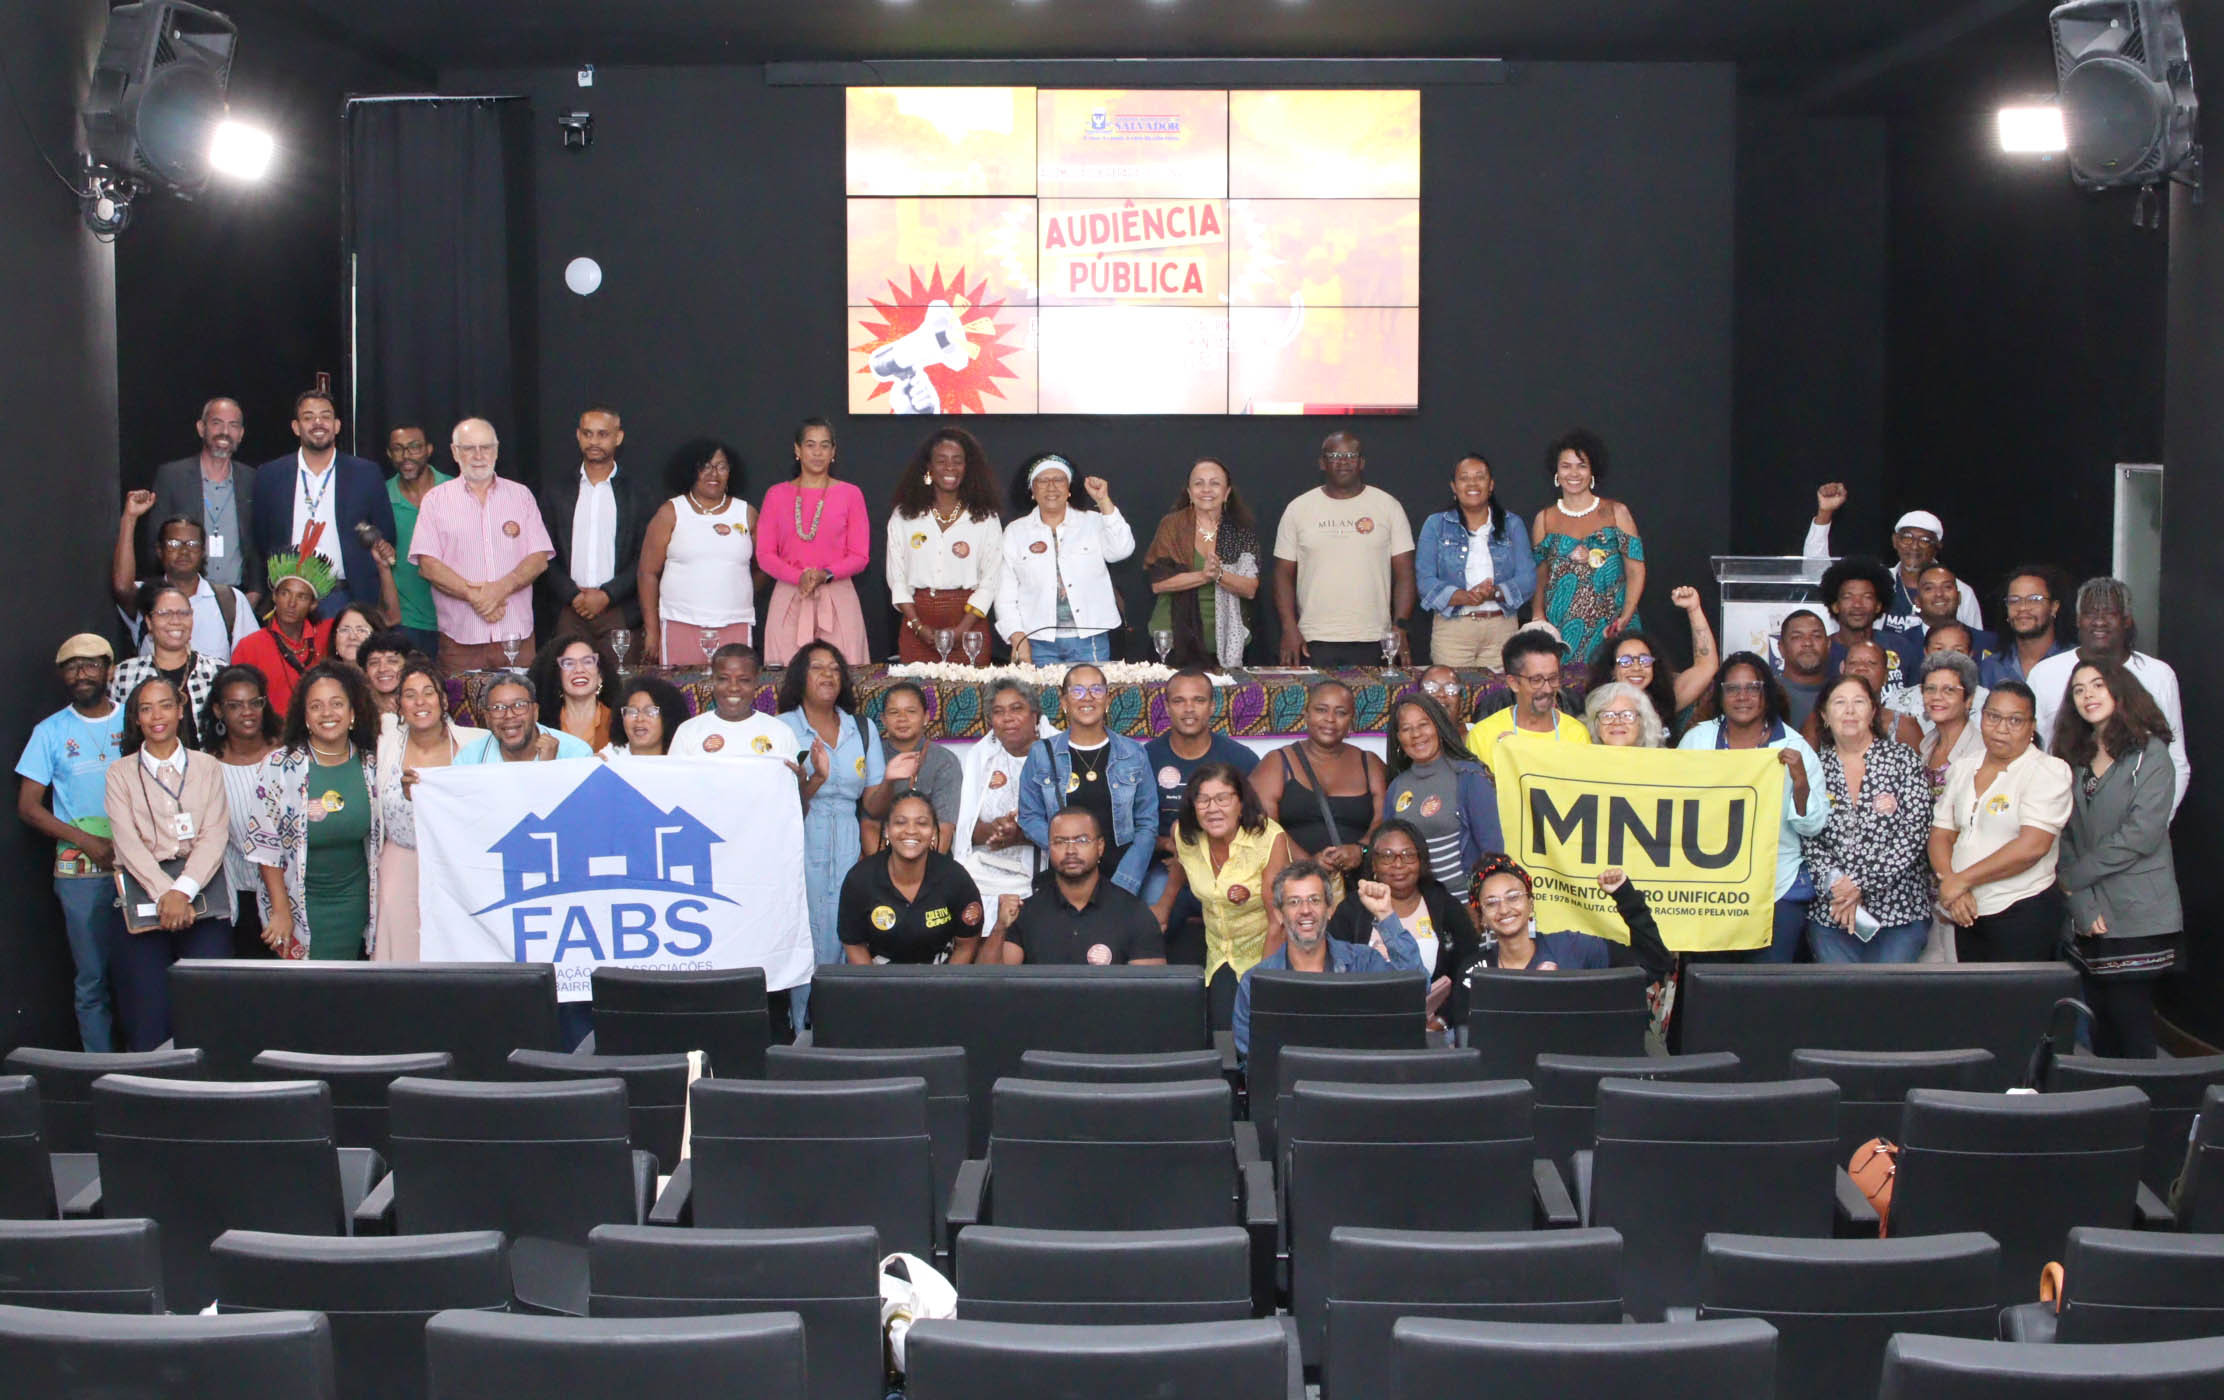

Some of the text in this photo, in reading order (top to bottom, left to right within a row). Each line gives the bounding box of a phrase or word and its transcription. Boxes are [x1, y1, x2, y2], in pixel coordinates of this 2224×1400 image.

[1045, 199, 1221, 249] AUDIÊNCIA
[1070, 252, 1203, 293] PÚBLICA
[1530, 788, 1745, 869] MNU
[1533, 876, 1608, 900] OVIMENTO
[1668, 890, 1750, 904] UNIFICADO
[1571, 899, 1582, 908] NA
[1583, 903, 1605, 912] LUTA
[1655, 907, 1696, 916] RACISMO
[1698, 908, 1703, 916] E
[1704, 908, 1726, 917] PELA
[1727, 909, 1750, 917] VIDA
[512, 899, 713, 964] FABS
